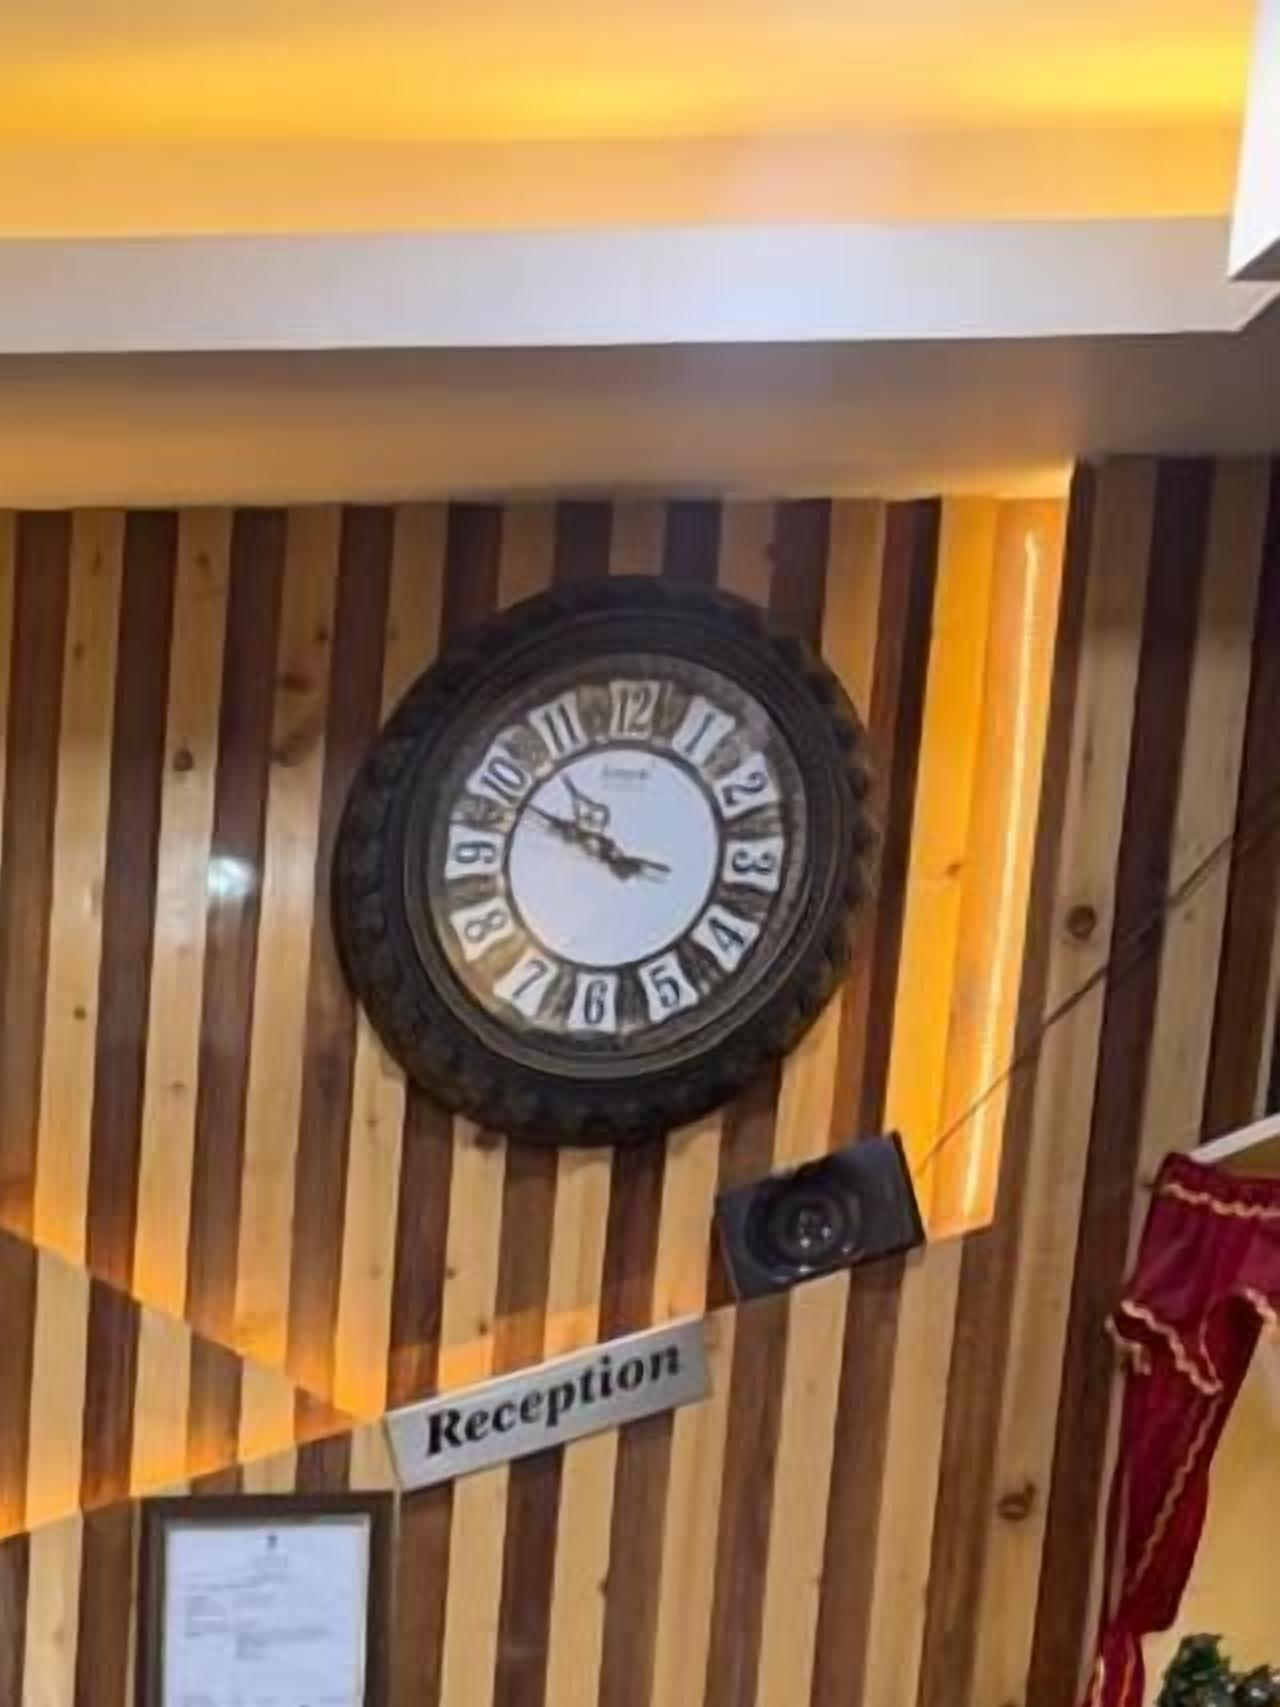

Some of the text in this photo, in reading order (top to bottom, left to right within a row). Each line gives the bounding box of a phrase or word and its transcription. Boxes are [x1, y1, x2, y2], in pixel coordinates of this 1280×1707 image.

[543, 703, 579, 750] 11
[618, 686, 653, 733] 12
[685, 712, 716, 752] 1
[480, 756, 525, 804] 10
[722, 770, 768, 806] 2
[455, 840, 497, 865] 9
[731, 850, 776, 876] 3
[464, 908, 507, 943] 8
[708, 915, 745, 951] 4
[511, 959, 548, 999] 7
[651, 965, 681, 1009] 5
[584, 980, 608, 1026] 6
[425, 1344, 681, 1457] Reception
